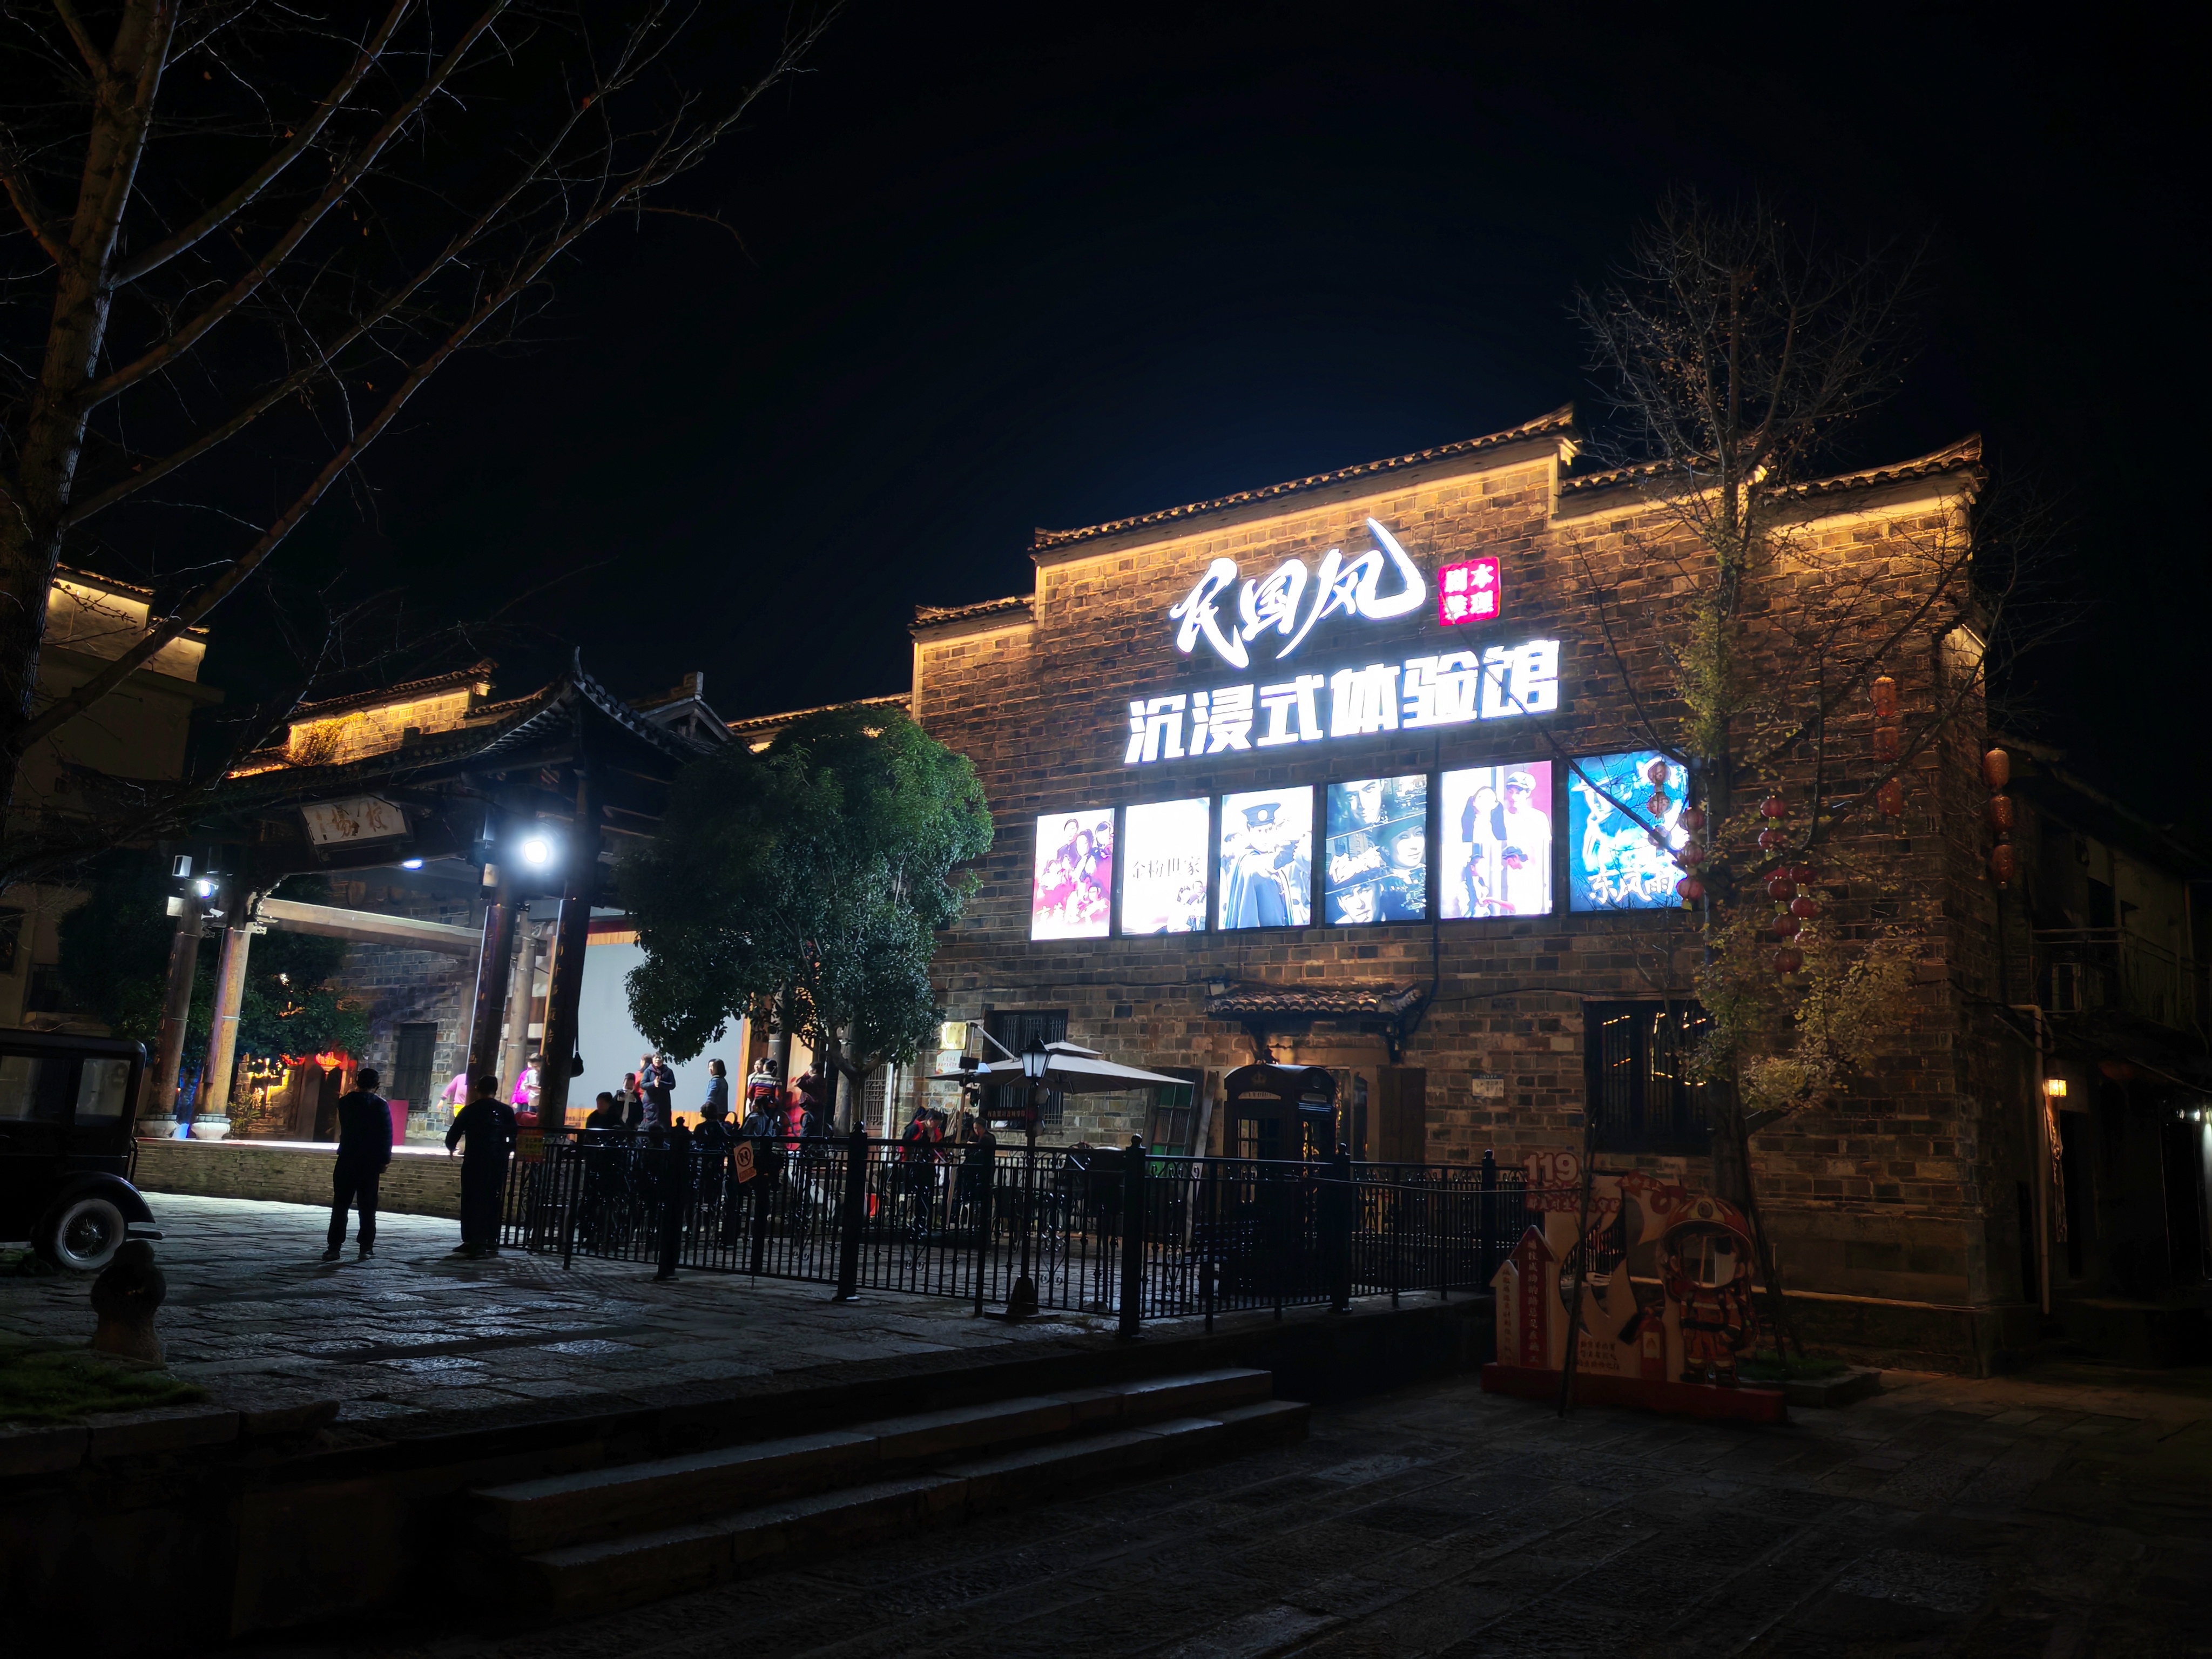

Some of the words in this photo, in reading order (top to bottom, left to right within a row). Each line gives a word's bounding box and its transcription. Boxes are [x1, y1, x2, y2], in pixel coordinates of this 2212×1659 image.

[1170, 517, 1427, 669] 民国风
[1124, 639, 1561, 763] 沉浸式体验馆
[1523, 1152, 1578, 1182] 119
